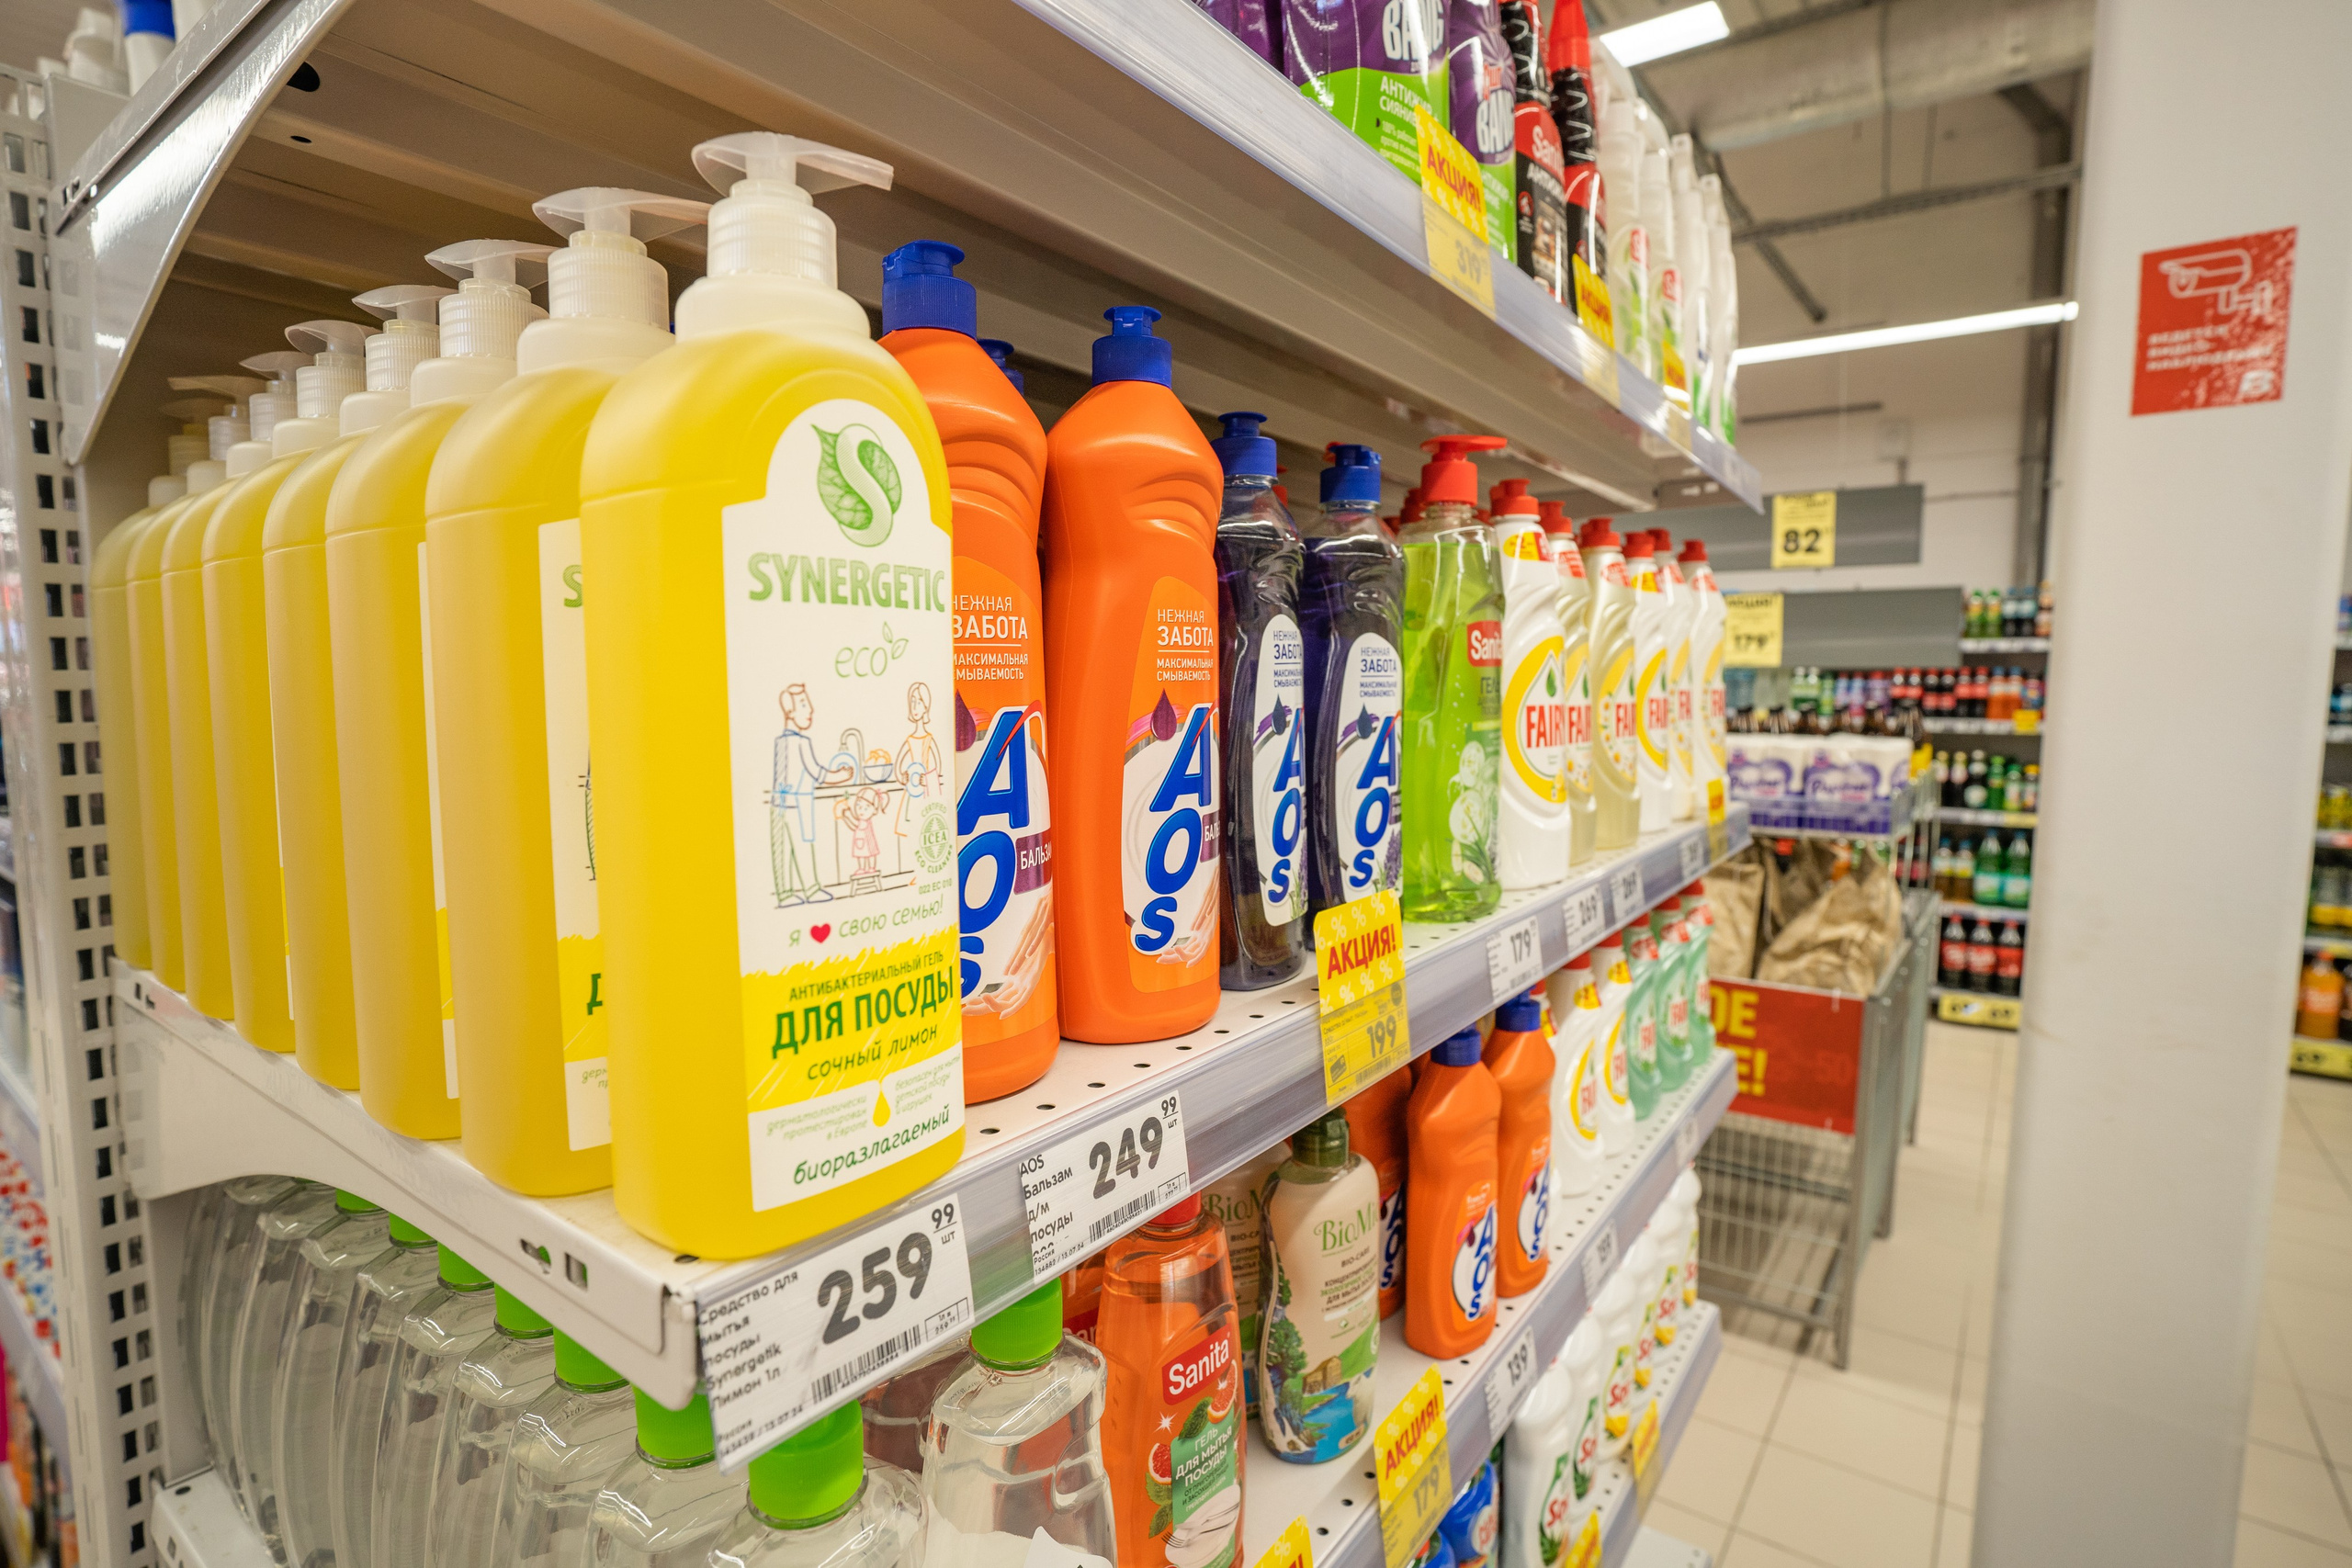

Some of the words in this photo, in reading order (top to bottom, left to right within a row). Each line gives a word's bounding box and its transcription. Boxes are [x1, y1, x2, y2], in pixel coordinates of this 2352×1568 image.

[1427, 144, 1482, 213] АКЦИЯ!
[1783, 528, 1821, 555] 82
[747, 551, 946, 614] SYNERGETIC
[953, 615, 1028, 640] ЗАБОТА
[1157, 609, 1204, 624] НЕЖНАЯ
[1157, 626, 1214, 647] ЗАБОТА
[1273, 630, 1298, 642] НЕЖНАЯ
[1361, 647, 1390, 657] НЕЖНАЯ
[834, 647, 888, 678] eco
[1157, 659, 1214, 670] МАКСИМАЛЬНАЯ
[1157, 671, 1211, 682] СМЫВАЕМОСТЬ
[1360, 659, 1396, 672] ЗАБОТА
[1349, 716, 1396, 888] AOS
[922, 829, 947, 846] ICEA
[1135, 706, 1213, 952] AOS
[788, 929, 801, 948] Я
[839, 912, 888, 940] свою
[891, 893, 944, 927] семью!
[1327, 922, 1396, 980] АКЦИЯ!
[1510, 928, 1532, 965] 179
[788, 955, 922, 1002] АНТИБАКТЕРИАЛЬНЫЙ
[922, 950, 944, 969] ГЕЛЬ
[772, 999, 843, 1060] ДЛЯ
[854, 965, 954, 1032] ПОСУДЫ
[807, 1040, 882, 1081] сочный
[888, 1024, 938, 1057] лимон
[1366, 1014, 1396, 1059] 199
[1160, 1096, 1177, 1117] 99
[1168, 1118, 1178, 1129] шт
[793, 1103, 950, 1185] биоразлагаемый
[1088, 1116, 1163, 1200] 249
[1020, 1154, 1045, 1179] AOS
[1023, 1166, 1073, 1201] Бальзам
[931, 1202, 955, 1230] 99
[1027, 1202, 1050, 1225] д/м
[1030, 1212, 1074, 1245] посуды
[940, 1231, 956, 1245] шт
[1034, 1249, 1056, 1266] Россия
[1035, 1258, 1057, 1276] 134882
[1061, 1241, 1085, 1261] 13.07.24
[698, 1285, 770, 1325] Средство
[774, 1270, 798, 1293] для
[817, 1231, 933, 1346] 259
[704, 1334, 761, 1367] посуды
[706, 1342, 782, 1392] Synergetik
[1168, 1337, 1230, 1396] Sanita
[1508, 1343, 1529, 1386] 139
[711, 1378, 761, 1408] Лимон
[764, 1366, 781, 1382] 1л
[1175, 1455, 1200, 1481] ДЛЯ
[1201, 1425, 1232, 1462] МЫТЬЯ
[1194, 1427, 1219, 1452] ГЕЛЬ
[1385, 1393, 1440, 1481] АКЦИЯ!
[1184, 1444, 1227, 1487] ПОСУДЫ
[1413, 1464, 1440, 1518] 179
